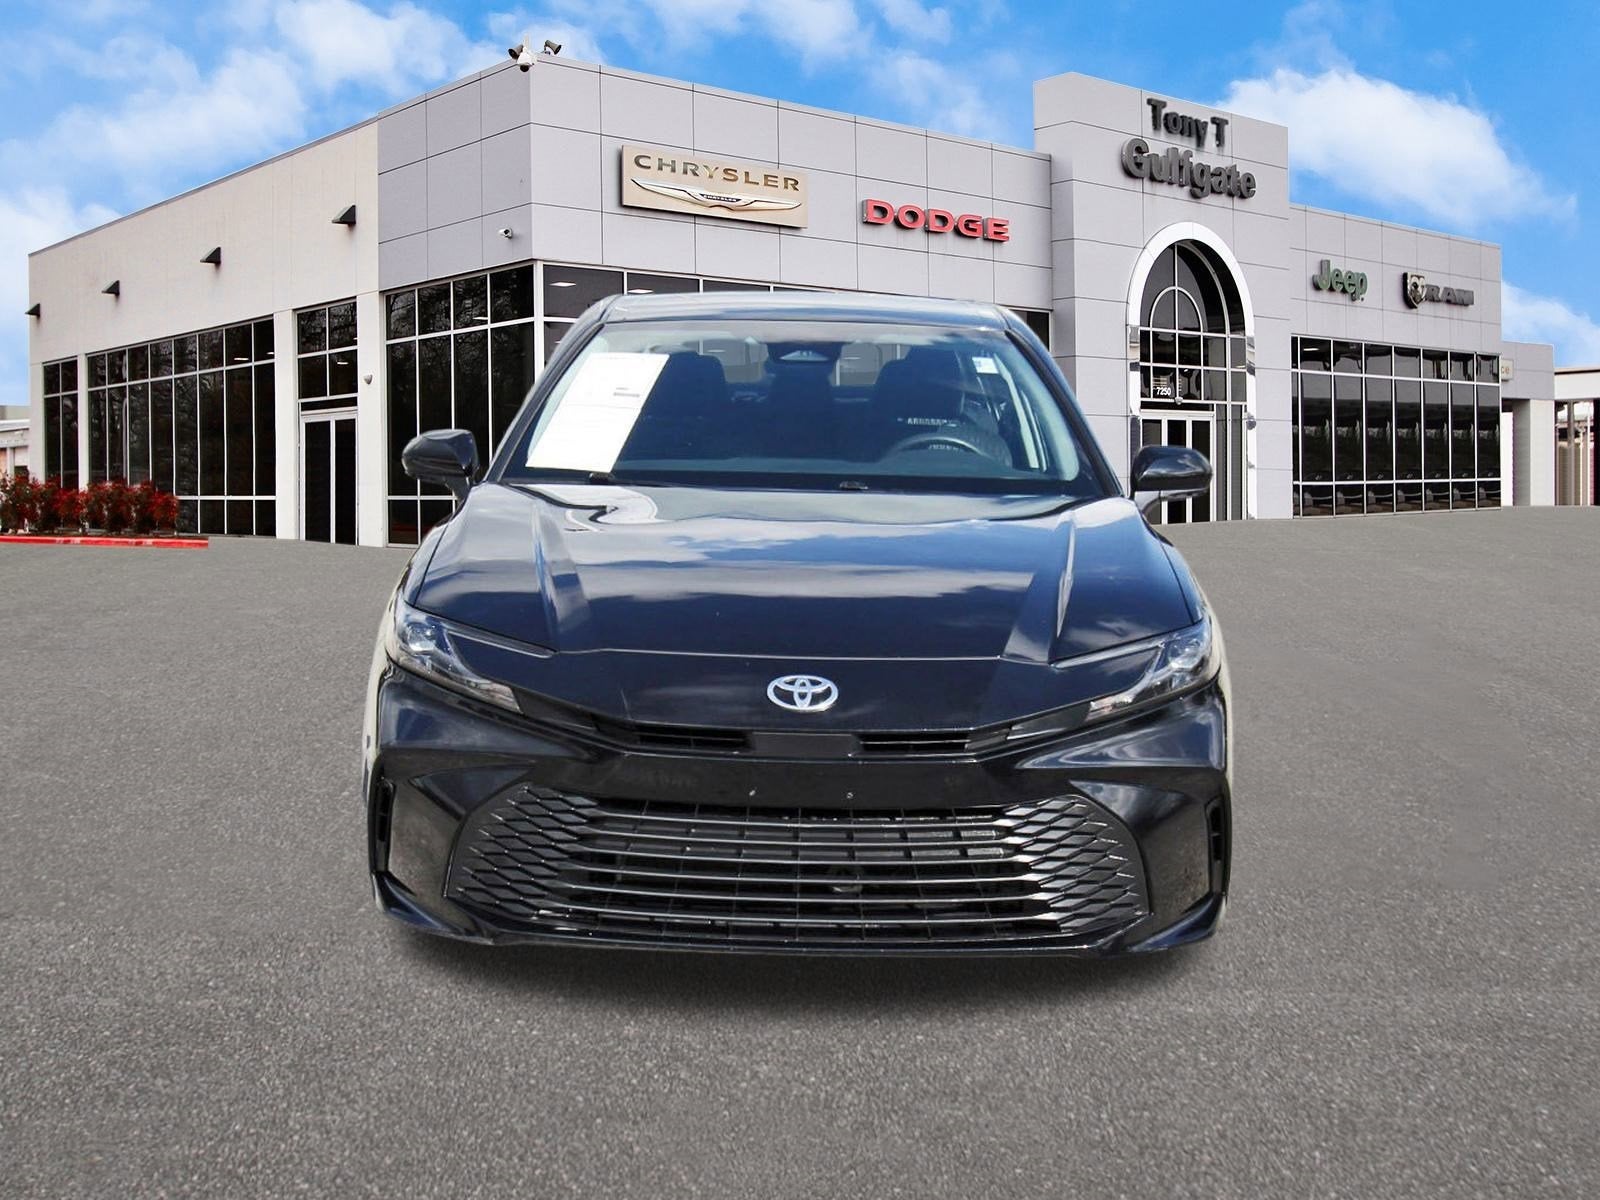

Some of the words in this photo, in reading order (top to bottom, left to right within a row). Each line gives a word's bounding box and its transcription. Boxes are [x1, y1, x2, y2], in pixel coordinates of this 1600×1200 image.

[1147, 98, 1208, 148] Tony
[1211, 117, 1229, 148] T
[633, 154, 800, 192] CHRYSLER
[1121, 138, 1256, 199] Gulfgate
[863, 198, 1010, 242] DODGE
[1312, 259, 1367, 302] Jeep
[1424, 284, 1474, 306] RAM
